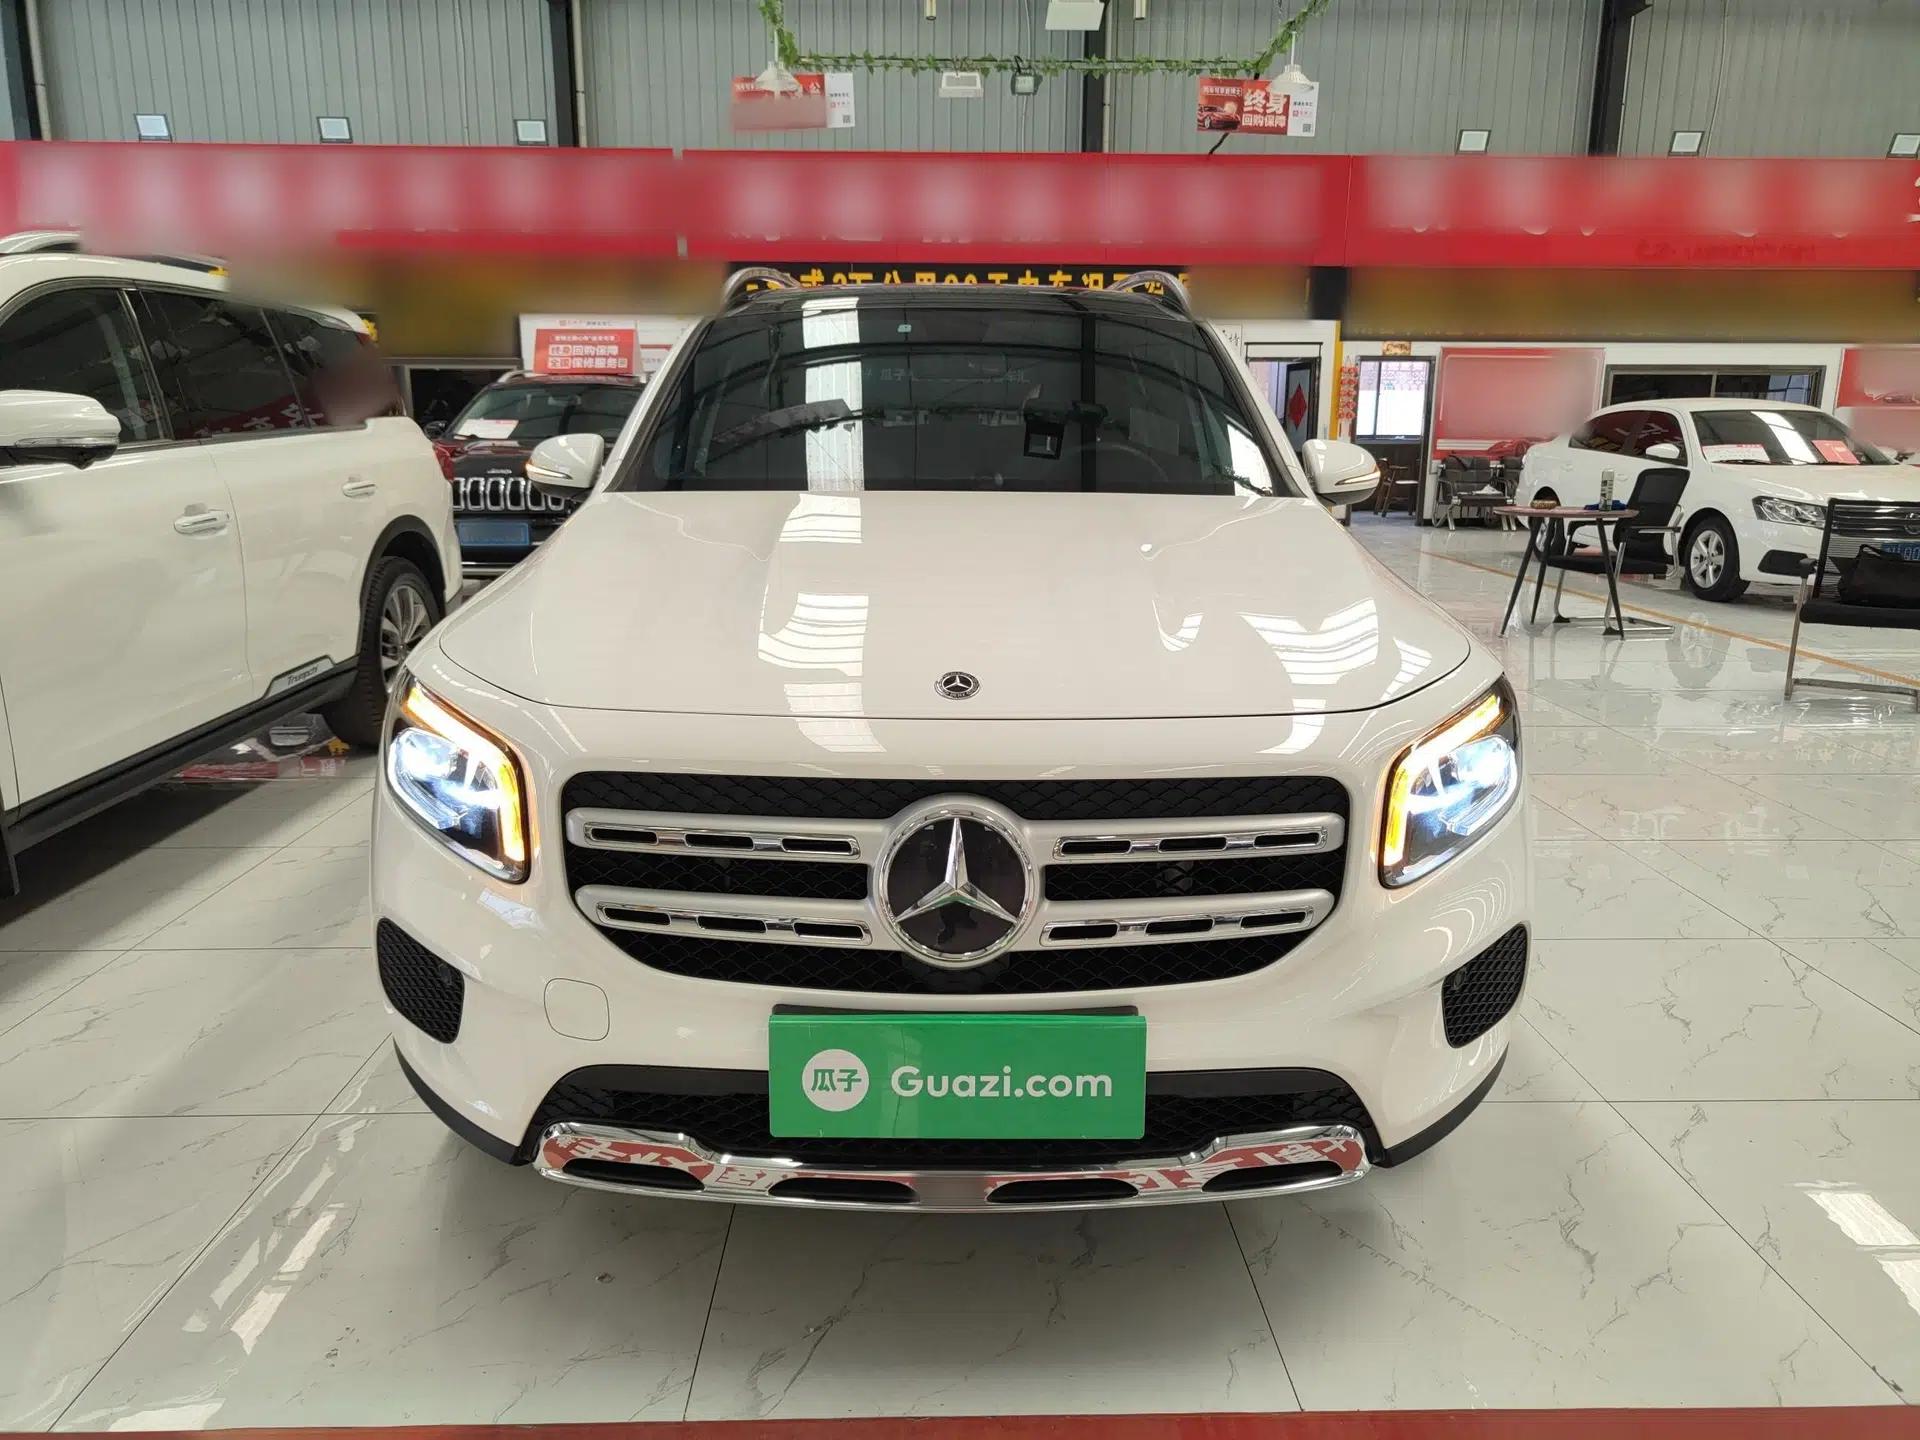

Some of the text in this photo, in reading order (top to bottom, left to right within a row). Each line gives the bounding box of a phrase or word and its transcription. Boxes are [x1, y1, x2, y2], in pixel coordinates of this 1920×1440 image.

[1243, 88, 1287, 113] 终身
[1242, 114, 1287, 127] 回购保障
[811, 1068, 862, 1093] 瓜子
[891, 1065, 1113, 1098] Guazi.com
